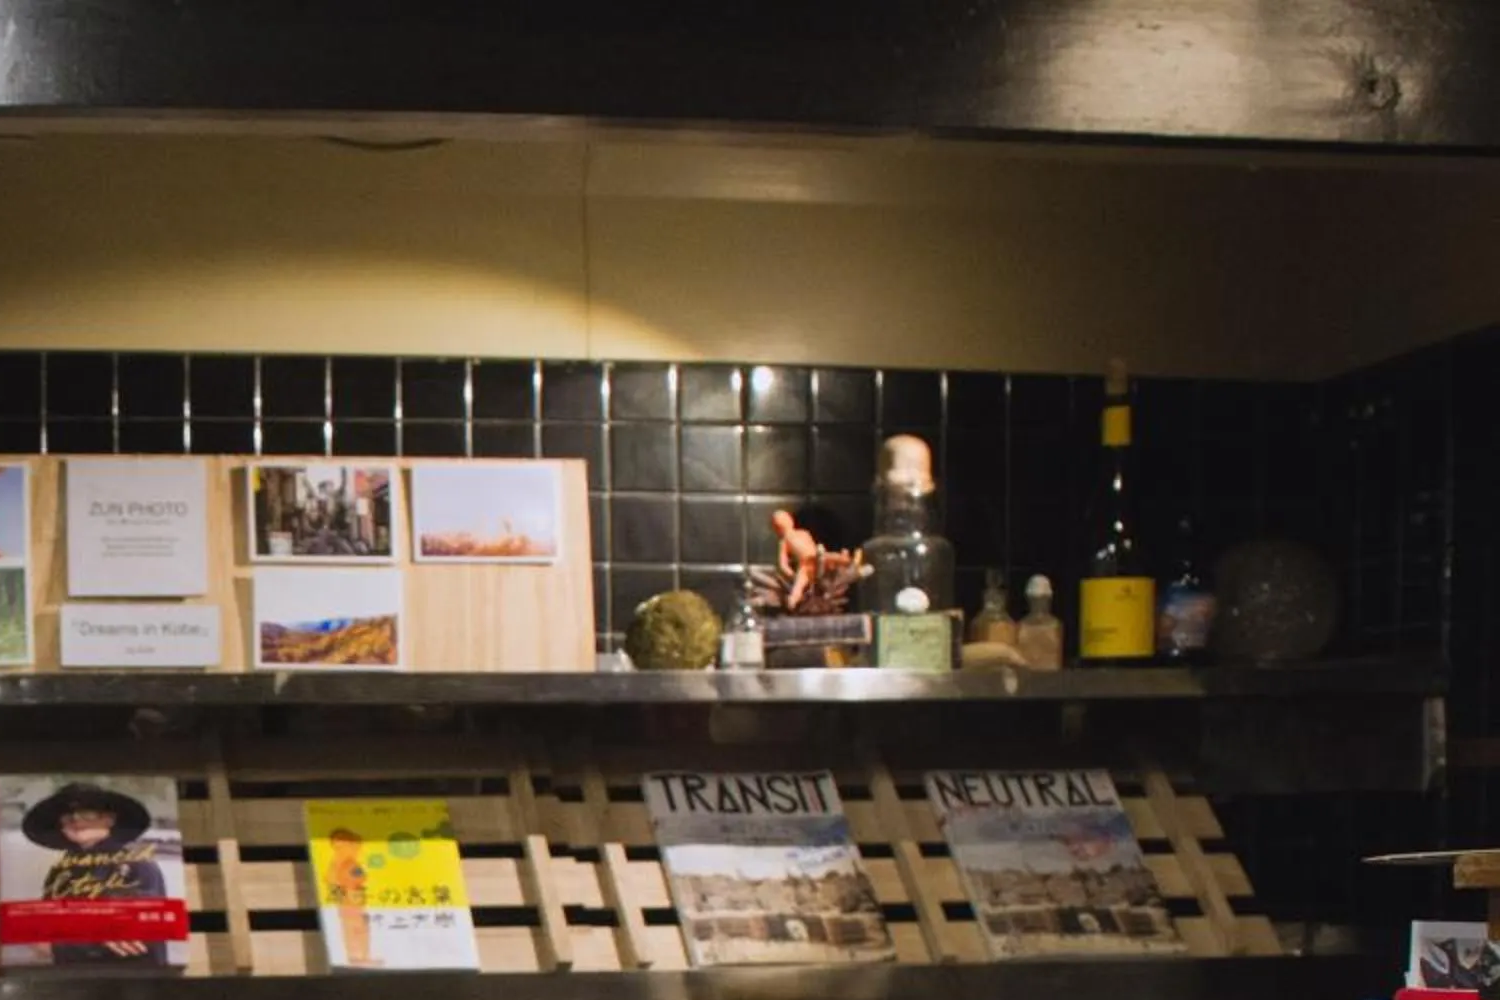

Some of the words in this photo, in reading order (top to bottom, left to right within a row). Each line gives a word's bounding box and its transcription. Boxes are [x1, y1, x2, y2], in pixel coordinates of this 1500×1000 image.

[127, 501, 189, 517] PHOTO
[650, 773, 830, 814] TRANSIT
[933, 770, 1116, 808] NEUTRAL
